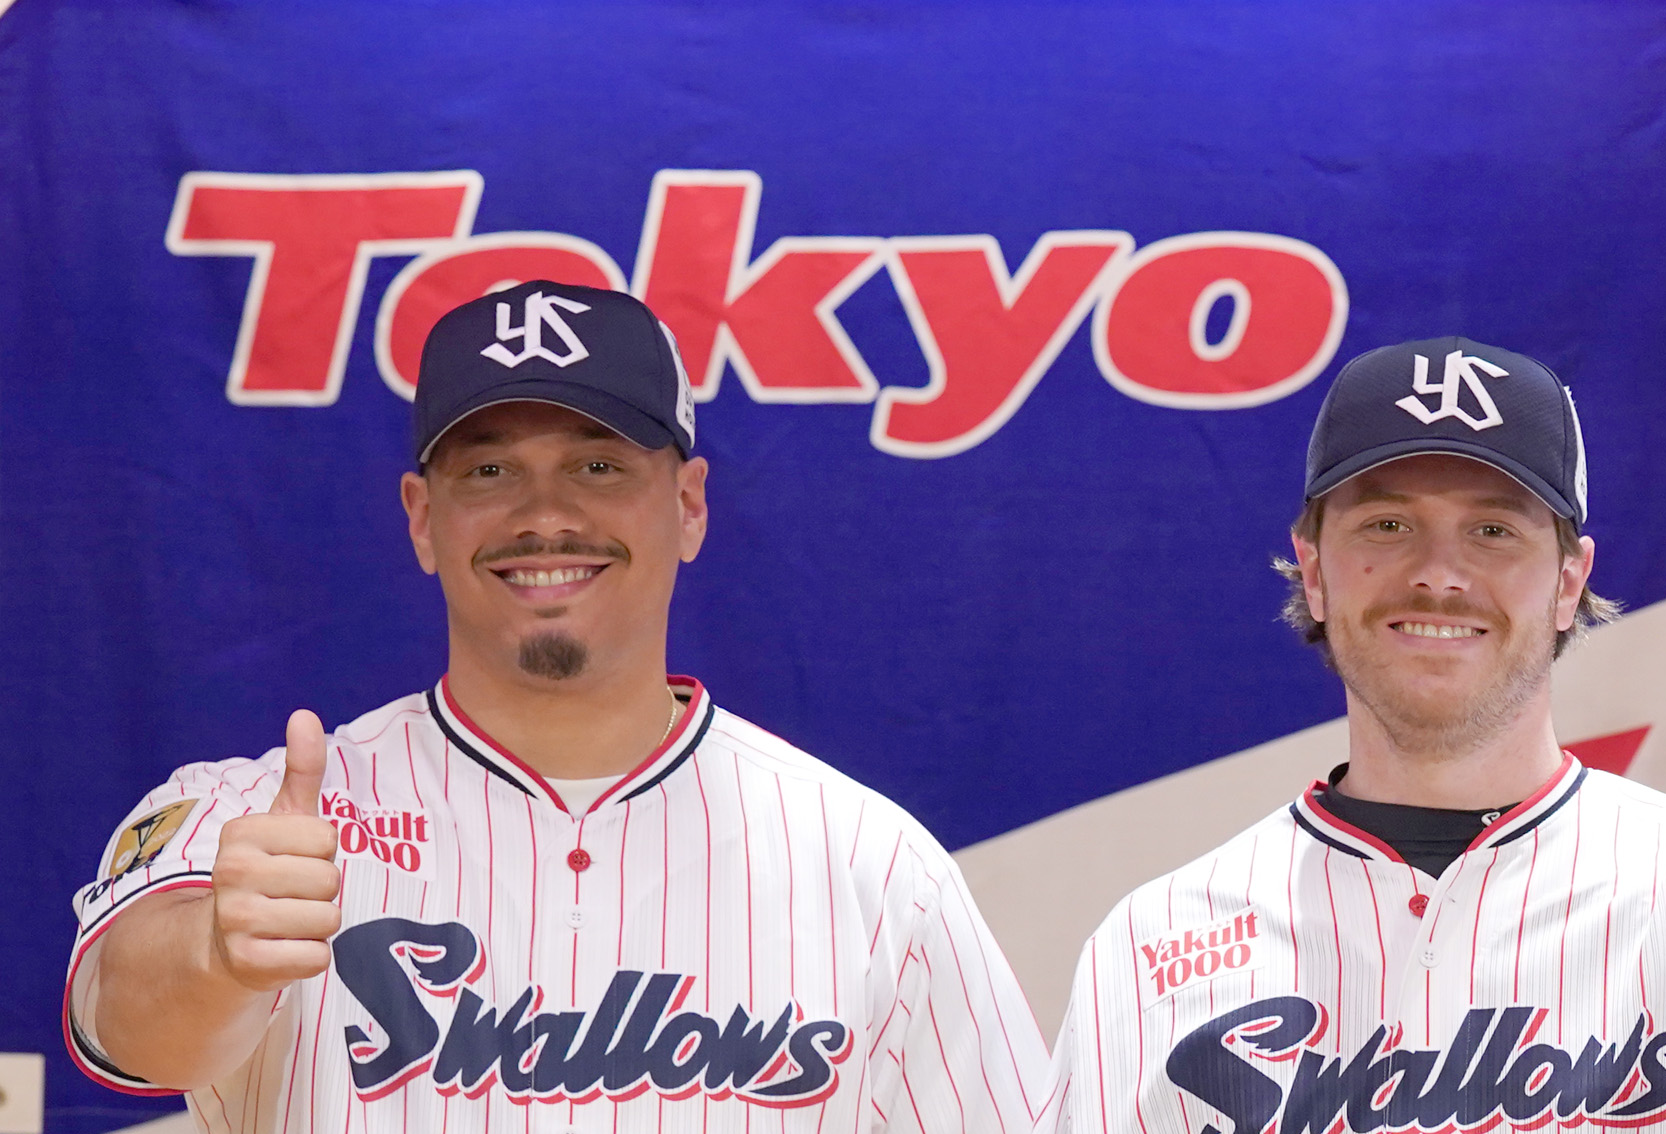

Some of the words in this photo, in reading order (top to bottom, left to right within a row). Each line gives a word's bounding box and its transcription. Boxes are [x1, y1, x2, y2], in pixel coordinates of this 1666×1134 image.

[329, 818, 421, 873] 000
[1140, 911, 1260, 970] Yakult
[1150, 943, 1252, 997] 1000
[331, 917, 855, 1110] Swallows
